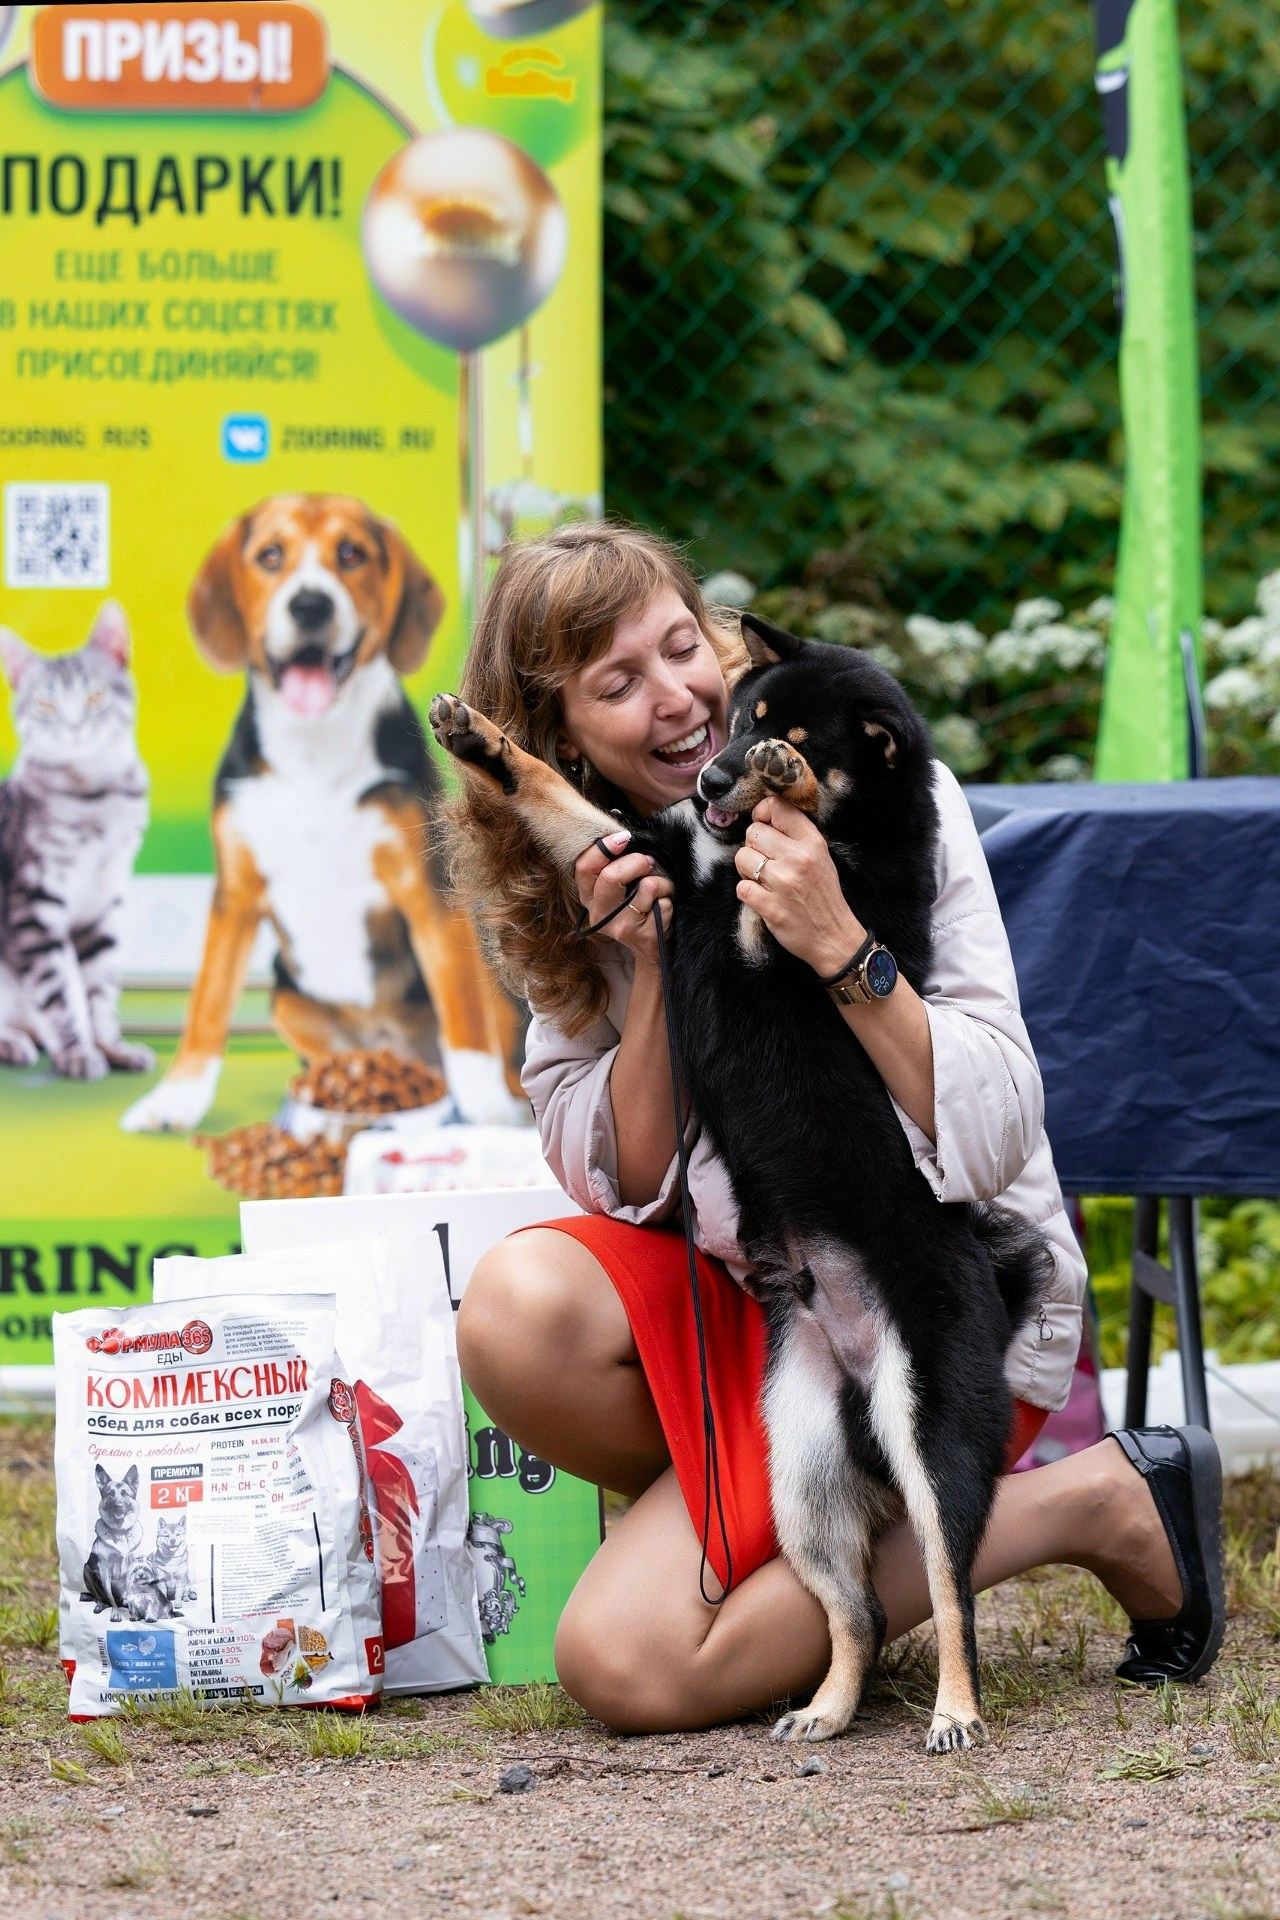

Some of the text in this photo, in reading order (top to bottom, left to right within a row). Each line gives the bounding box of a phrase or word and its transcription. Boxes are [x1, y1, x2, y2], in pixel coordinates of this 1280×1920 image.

[61, 18, 294, 84] ПРИЗЫ!
[1, 156, 343, 227] ПОДАРКИ!
[54, 249, 281, 284] ЕЩЕ БОЛЬШЕ
[29, 301, 151, 330] НАШИХ
[162, 299, 339, 336] СОЦСЕТЯХ
[182, 1328, 212, 1346] 365
[157, 1351, 183, 1365] ЕДЫ
[87, 1355, 307, 1409] КОМПЛЕКСНЫЙ
[87, 1416, 128, 1431] обед
[133, 1418, 164, 1431] для
[170, 1412, 220, 1427] собак
[225, 1407, 262, 1421] всех
[88, 1443, 133, 1461] Сделано
[211, 1440, 244, 1450] PROTEIN
[154, 1465, 200, 1478] ПРЕМИУМ
[158, 1486, 194, 1504] 2 КГ
[213, 1636, 235, 1644] МАСЛА
[188, 1648, 220, 1656] УГЛЕВОДЫ
[189, 1658, 223, 1667] КЛЕТЧАТКА
[190, 1669, 222, 1677] ВИТАМИНЫ
[197, 1677, 229, 1685] МИНЕРАЛЫ
